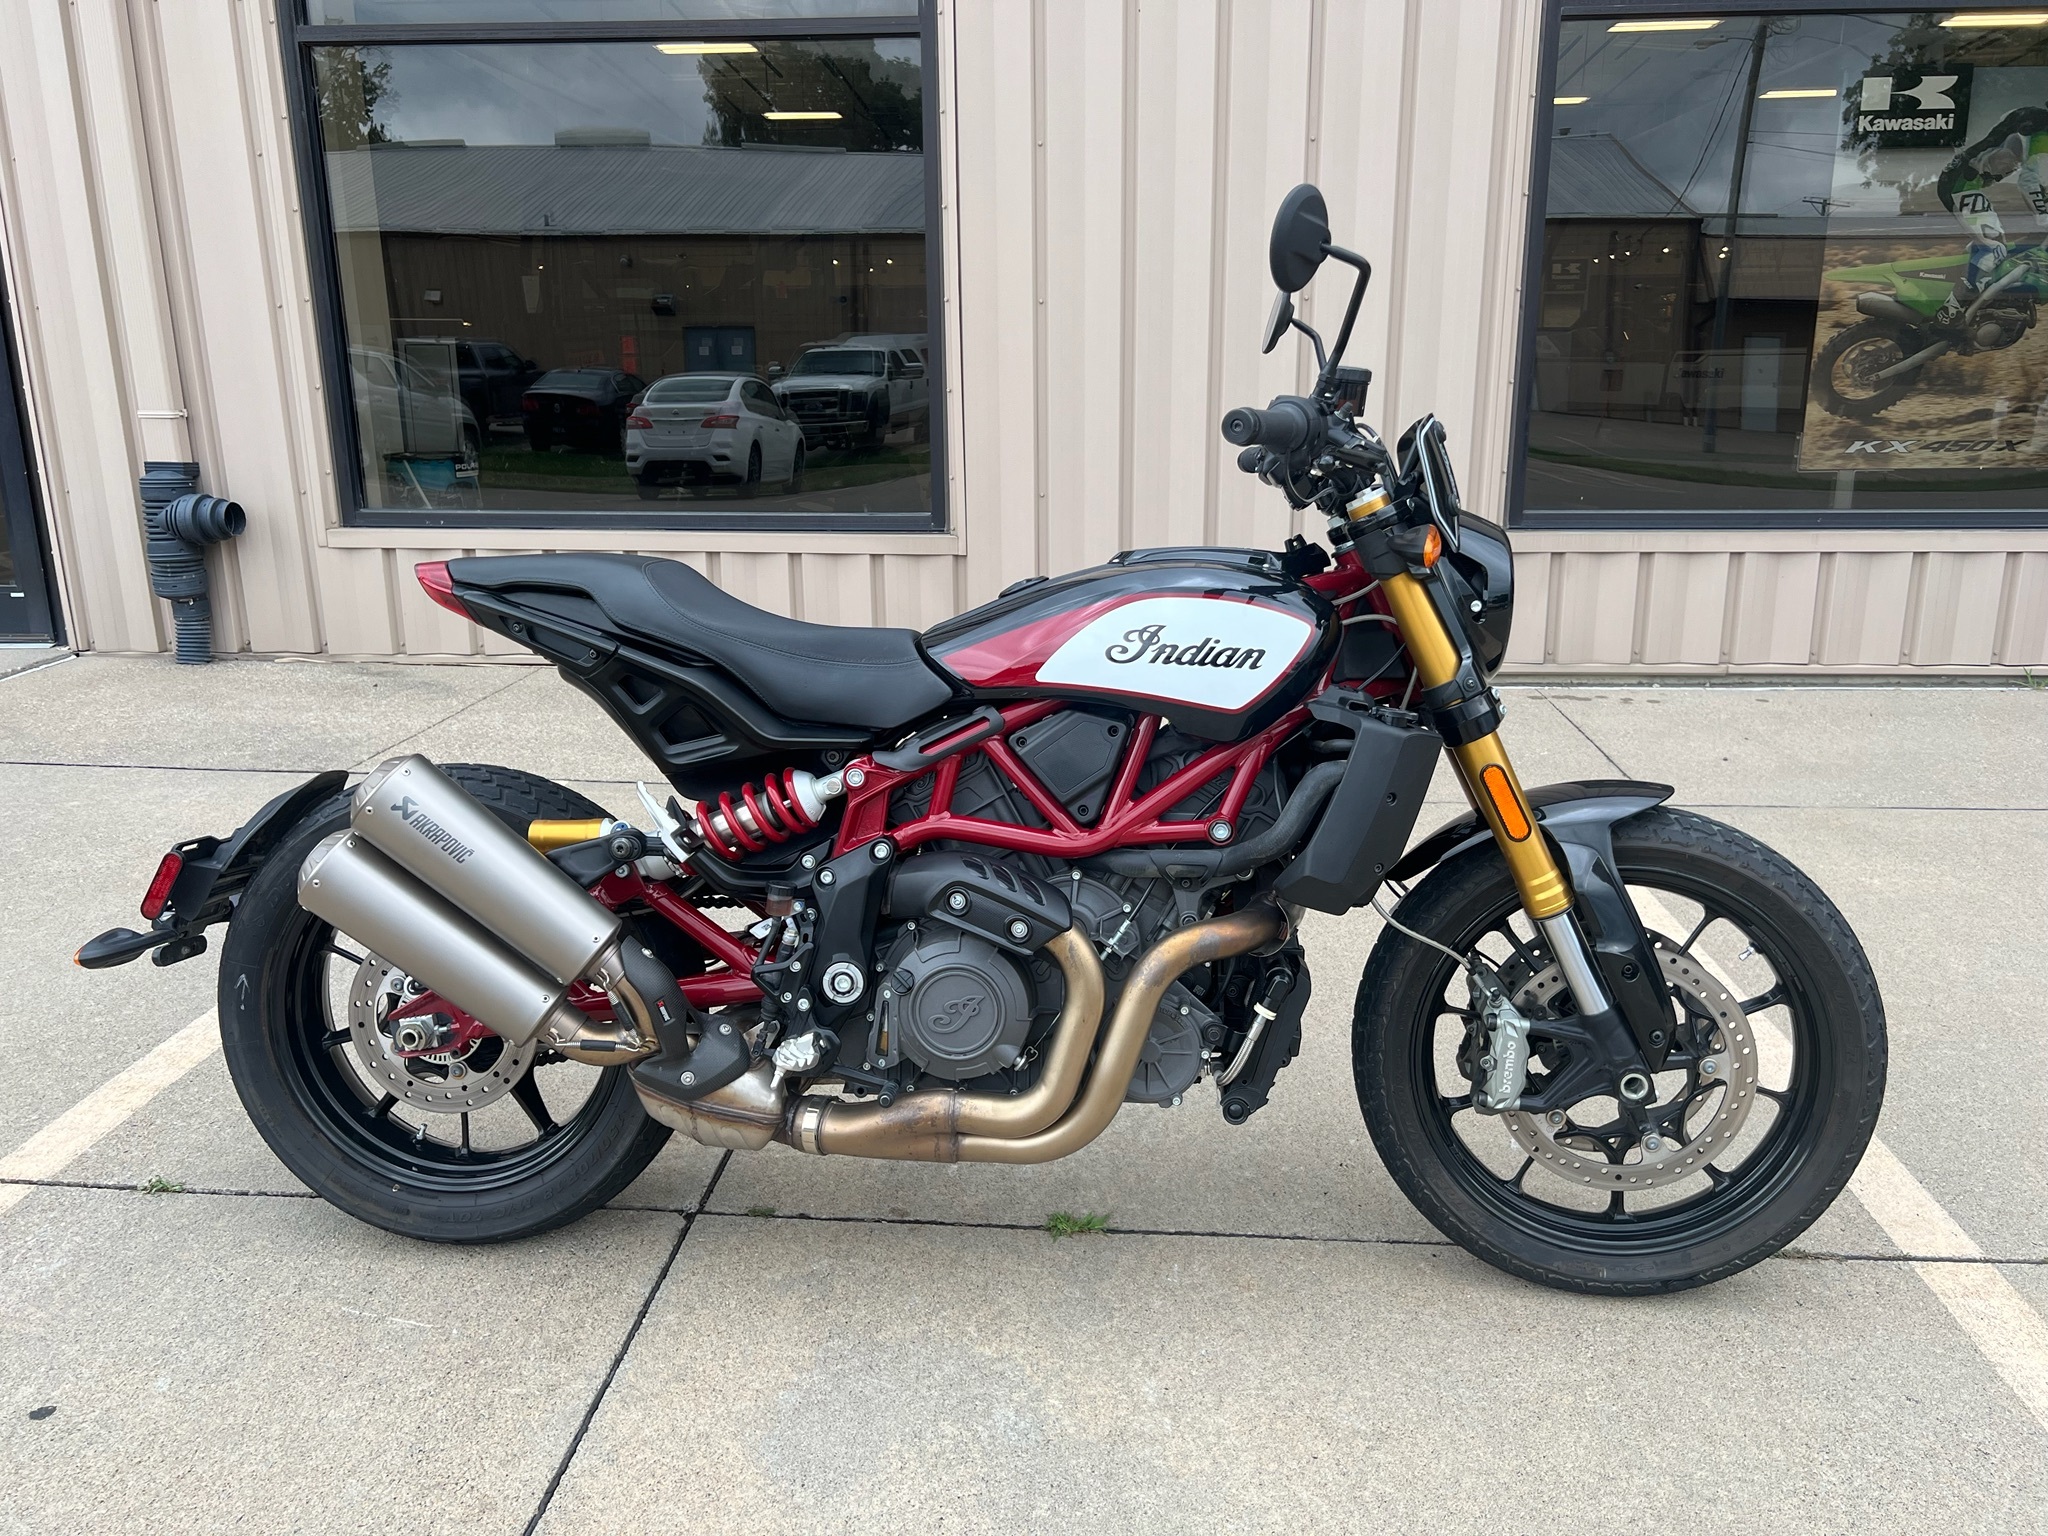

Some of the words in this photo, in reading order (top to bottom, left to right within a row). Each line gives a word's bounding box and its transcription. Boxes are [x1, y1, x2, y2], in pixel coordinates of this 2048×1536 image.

[1858, 113, 1955, 132] Kawasaki
[1959, 193, 1993, 214] FOX
[1104, 624, 1267, 670] Indian
[1498, 1040, 1517, 1094] brembo
